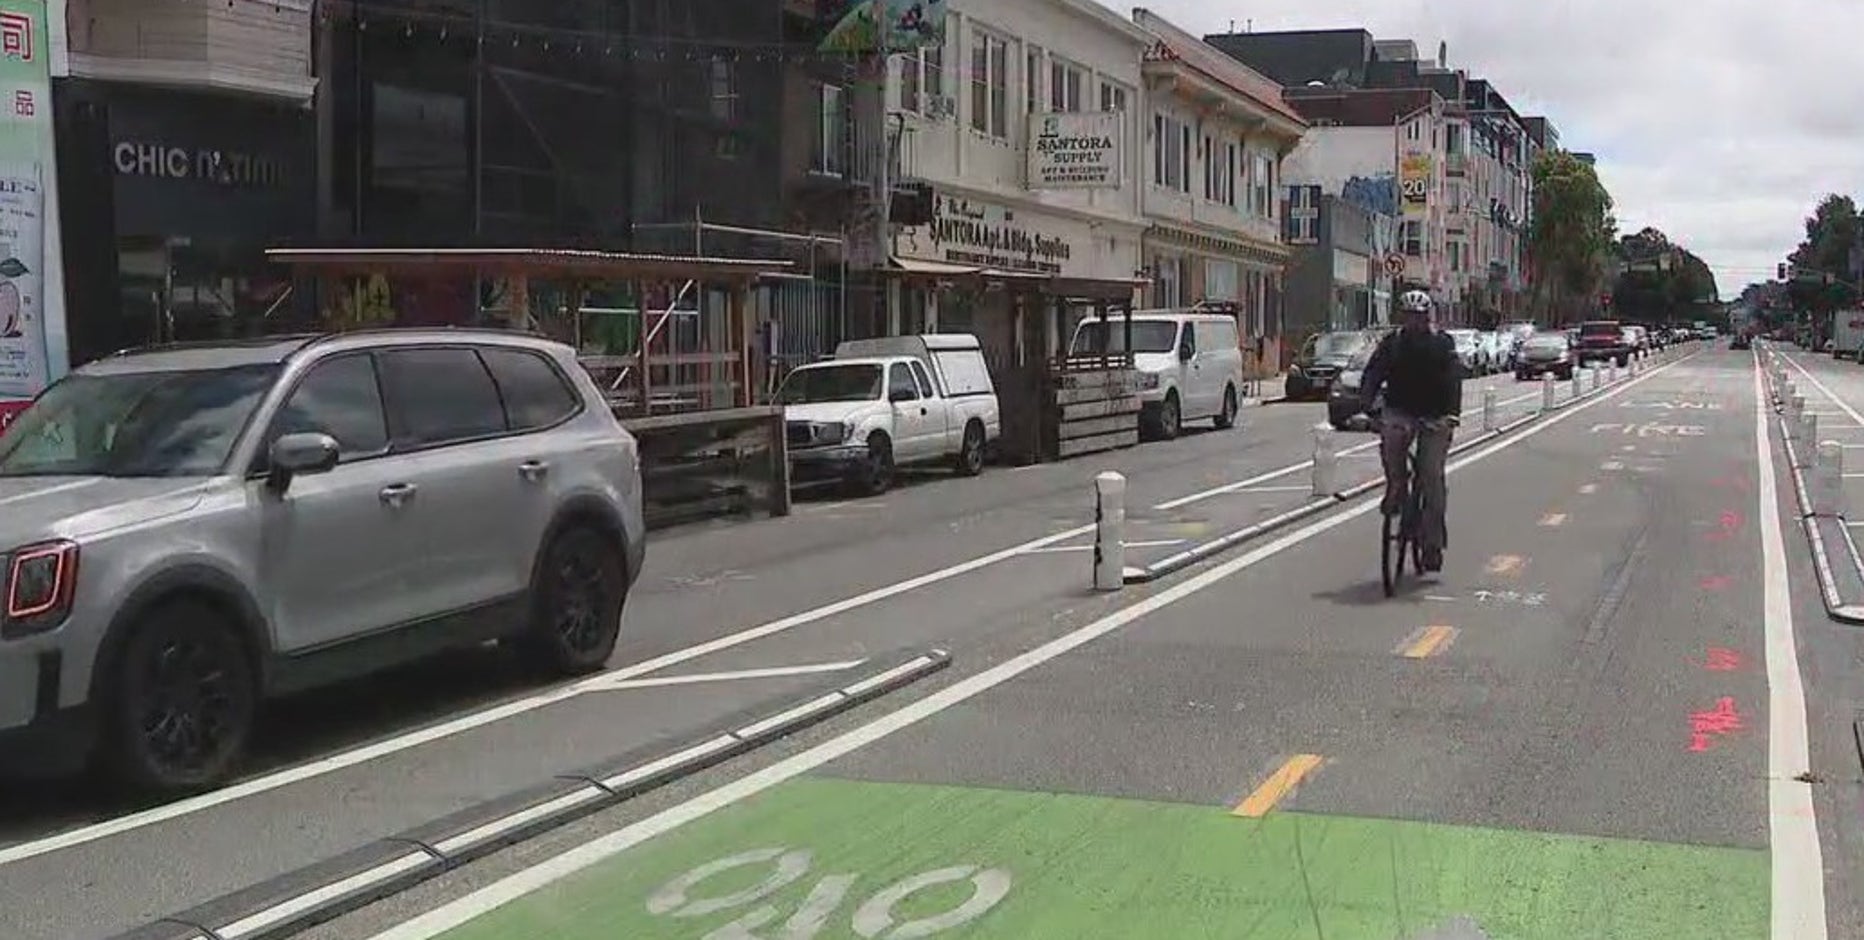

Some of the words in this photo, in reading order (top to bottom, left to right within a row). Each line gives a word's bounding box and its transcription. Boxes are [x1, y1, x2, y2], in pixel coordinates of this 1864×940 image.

[1036, 136, 1112, 151] SANTORA
[114, 141, 188, 178] CHIC
[1053, 151, 1102, 164] SUPPLY
[1403, 179, 1426, 196] 20
[929, 217, 981, 246] SANTORA
